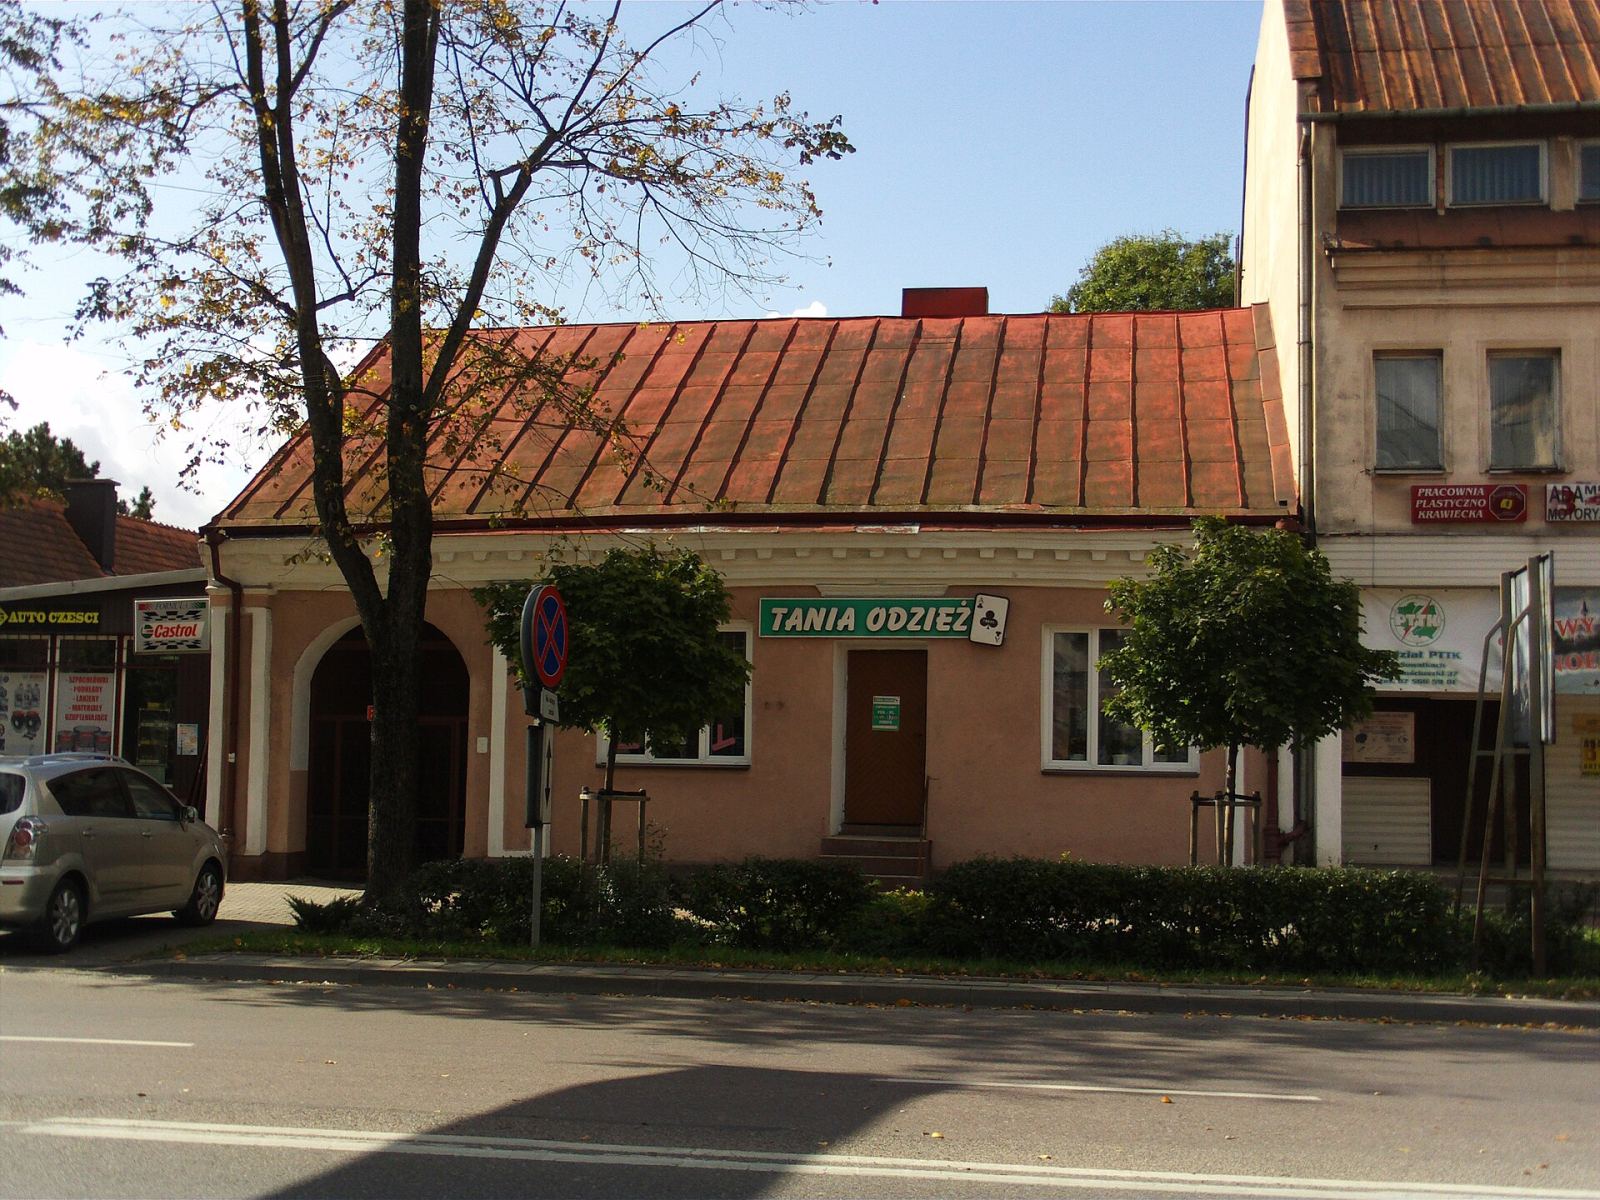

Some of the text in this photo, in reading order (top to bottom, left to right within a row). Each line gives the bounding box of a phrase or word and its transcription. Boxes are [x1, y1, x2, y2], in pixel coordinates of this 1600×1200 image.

[1417, 487, 1485, 497] PRACOWNIA
[1416, 499, 1487, 508] PLASTYCZNO
[1418, 509, 1483, 519] KRAWIECKA
[1548, 508, 1600, 520] MOTORY
[8, 611, 99, 624] AUTO CZESCI
[771, 600, 972, 631] TANIA ODZIEŻ
[154, 624, 198, 638] Castrol
[1429, 651, 1462, 659] PTTK
